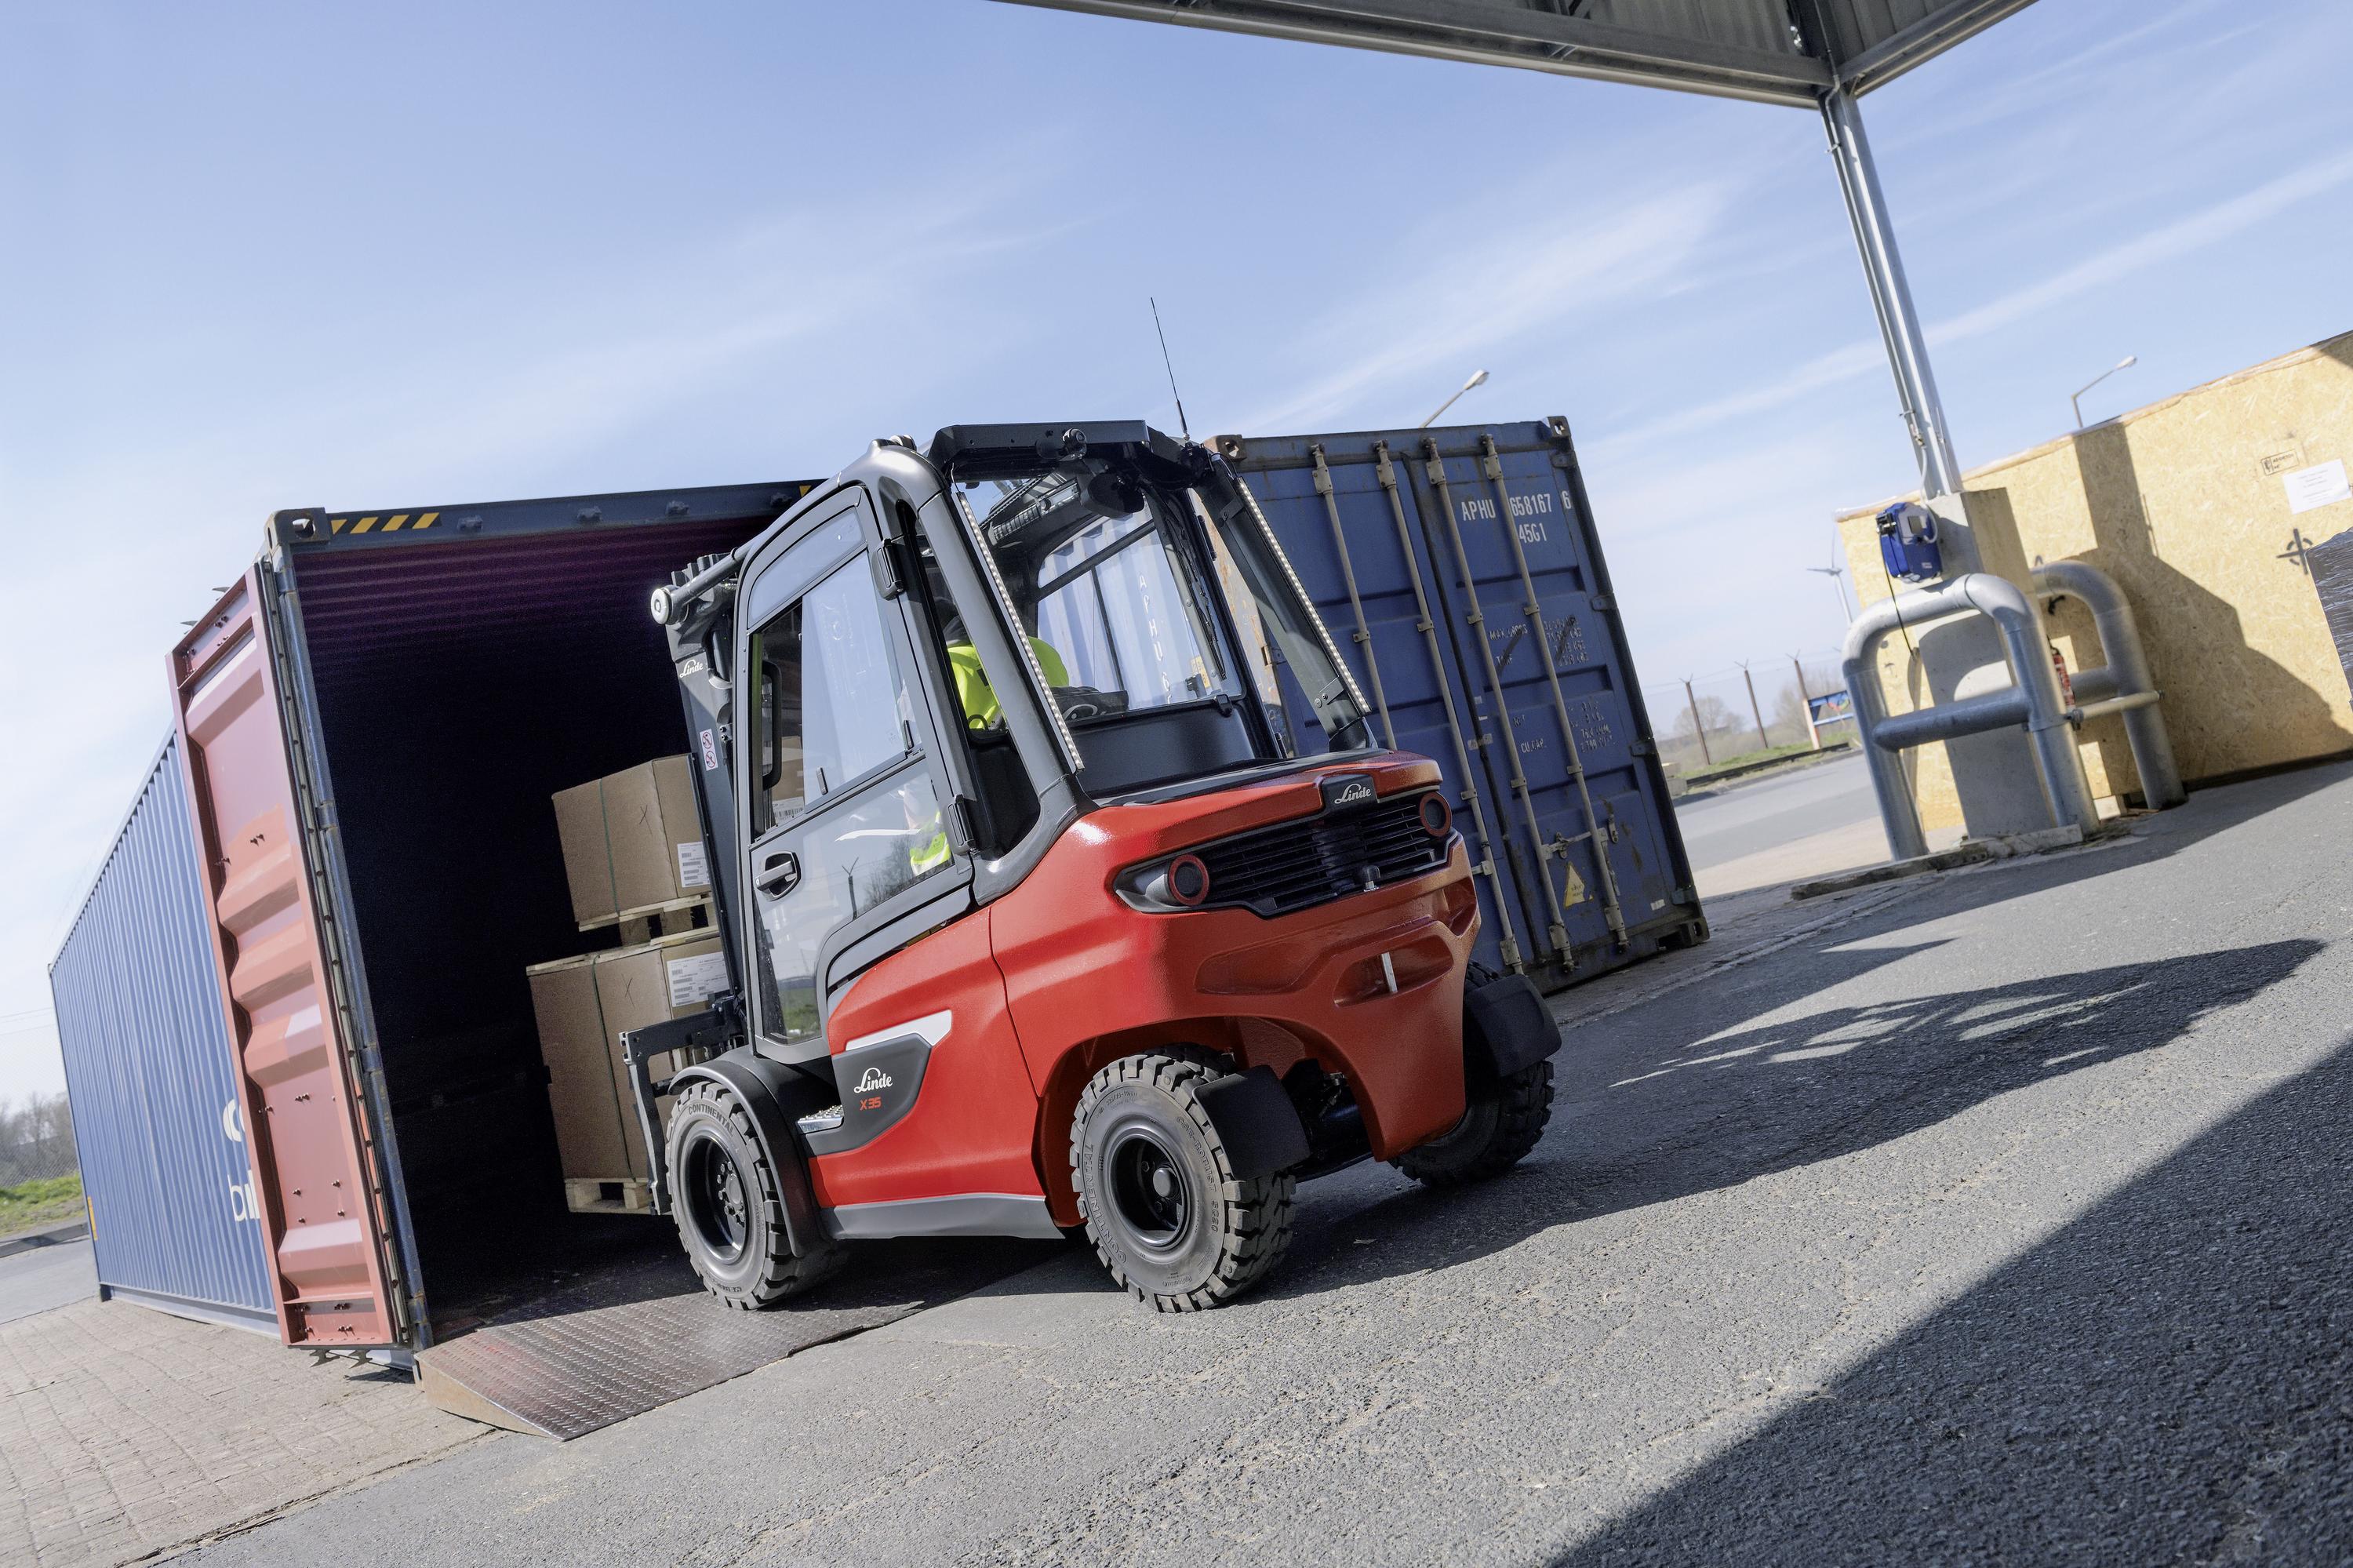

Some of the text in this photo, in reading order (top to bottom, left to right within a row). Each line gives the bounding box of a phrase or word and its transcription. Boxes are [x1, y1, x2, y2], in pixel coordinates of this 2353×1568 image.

[1460, 490, 1572, 522] APHU 658167 6
[1518, 522, 1547, 544] 45G1
[679, 659, 704, 678] Linde
[1334, 783, 1372, 804] Linde
[853, 1067, 893, 1093] Linde
[860, 1096, 882, 1111] X35
[688, 1104, 734, 1137] CONTINENTAL
[1084, 1144, 1127, 1264] CONTINENTAL
